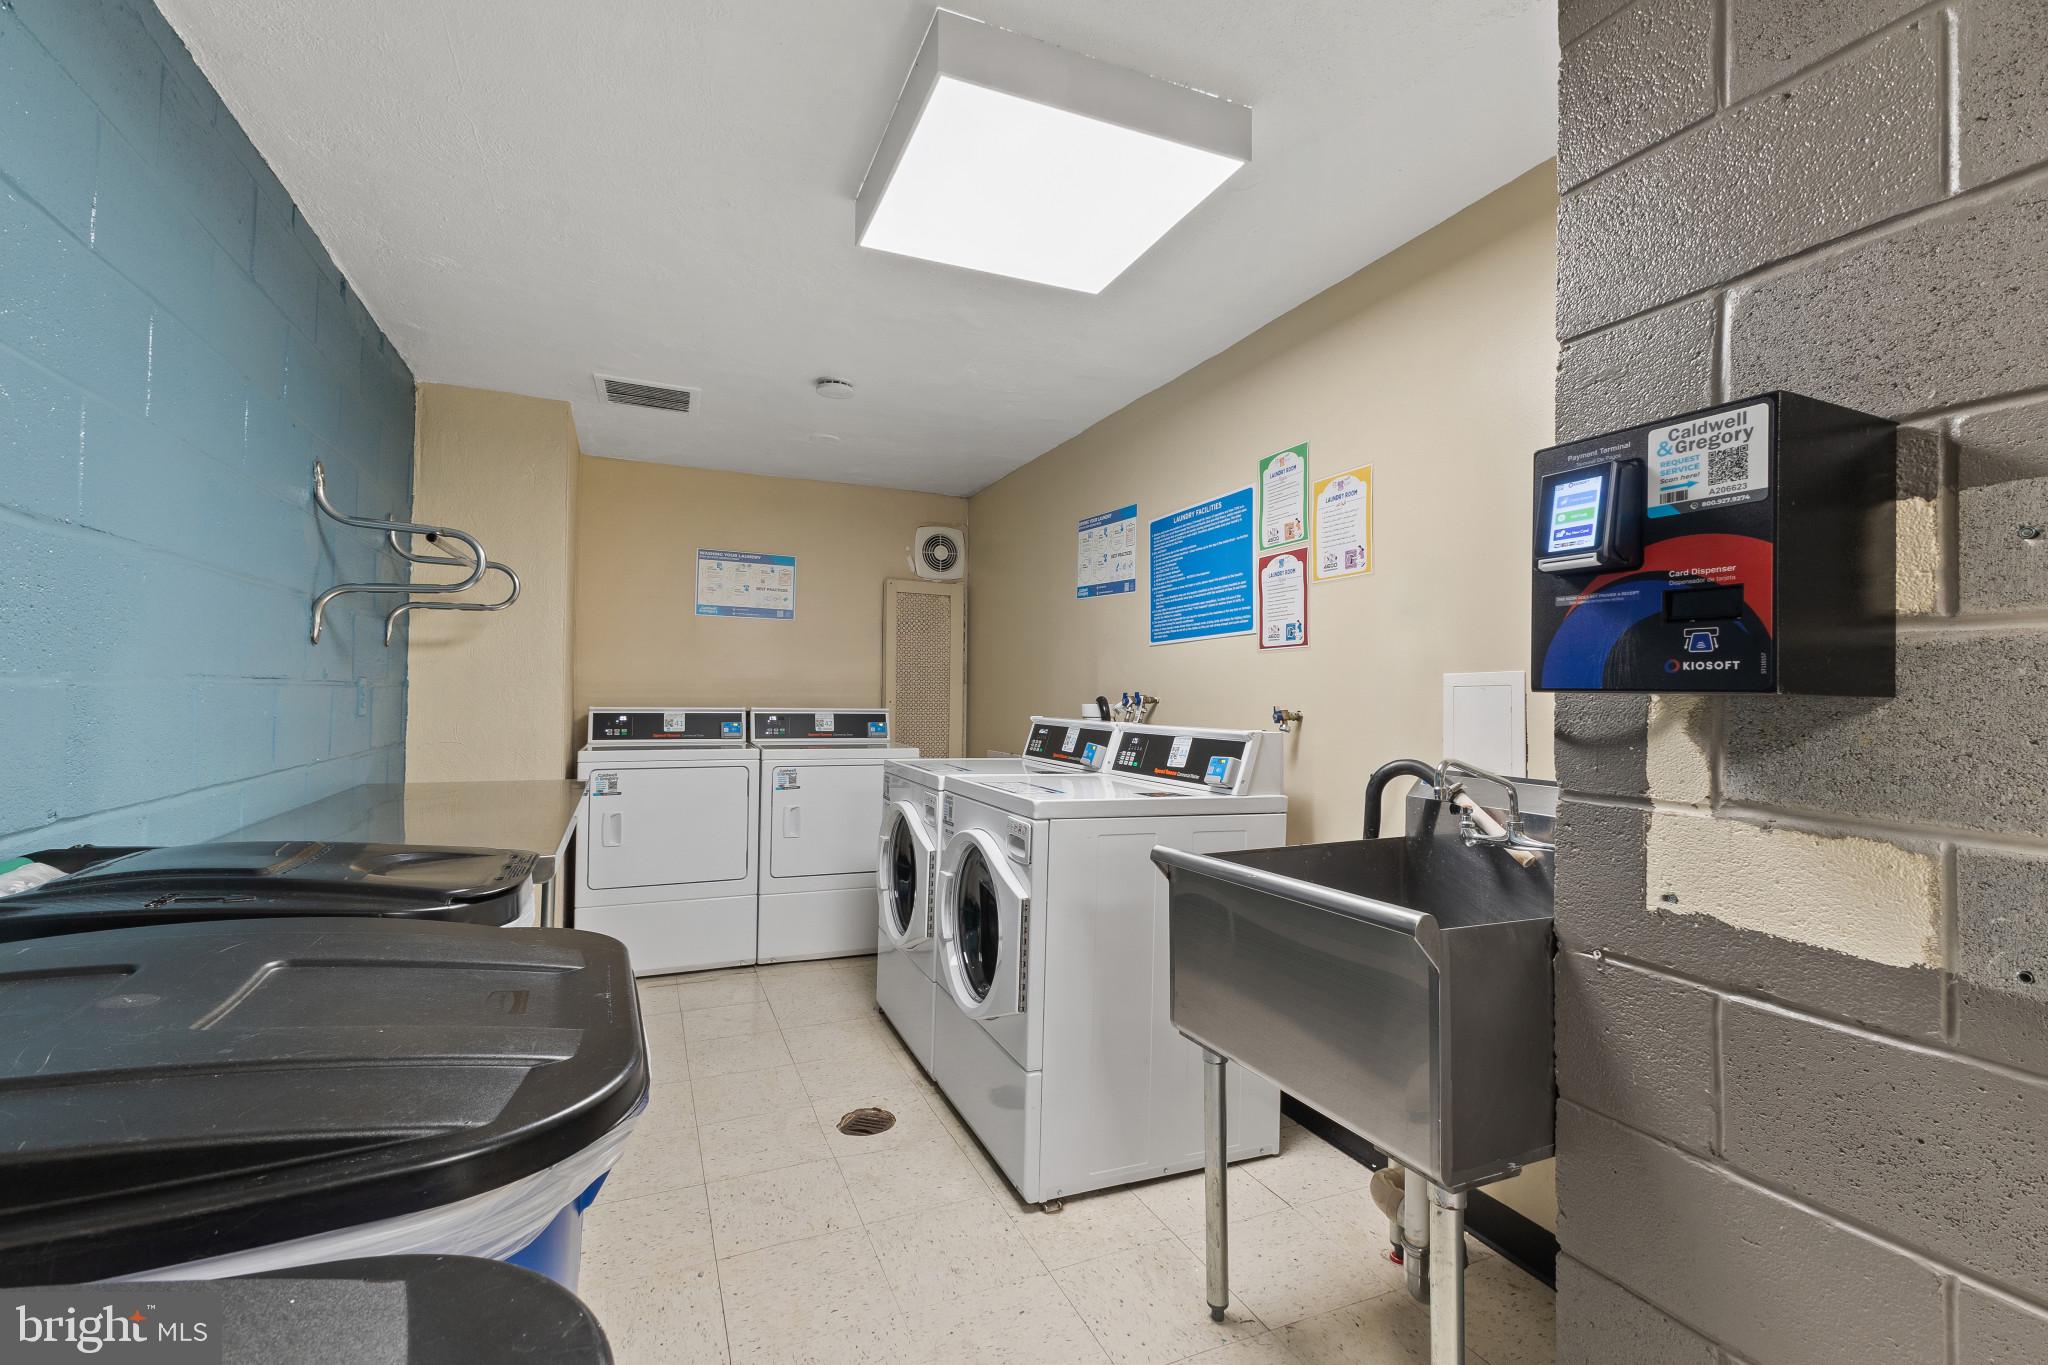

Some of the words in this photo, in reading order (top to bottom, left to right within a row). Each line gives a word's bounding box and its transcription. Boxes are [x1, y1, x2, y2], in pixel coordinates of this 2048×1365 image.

[1668, 411, 1747, 442] Caldwell
[1675, 426, 1754, 454] Gregory
[1567, 450, 1598, 462] Payment
[1600, 441, 1631, 454] Terminal
[1660, 454, 1701, 468] REQUEST
[1270, 469, 1286, 479] LAUNDRY
[1286, 464, 1296, 473] ROOM
[1660, 463, 1700, 477] SERVICE
[1660, 476, 1679, 485] Scan
[1680, 472, 1701, 481] here!
[1708, 483, 1748, 496] A206623
[1326, 494, 1344, 504] LAUNDRY
[1345, 490, 1358, 498] ROOM
[1174, 511, 1195, 524] LAUNDRY
[1196, 502, 1222, 516] FACILITIES
[1268, 570, 1284, 578] LAUNDRY
[1669, 568, 1689, 578] Card
[1692, 565, 1737, 576] Dispenser
[1669, 578, 1706, 586] Dispensador
[1682, 660, 1740, 670] KIOSOFT
